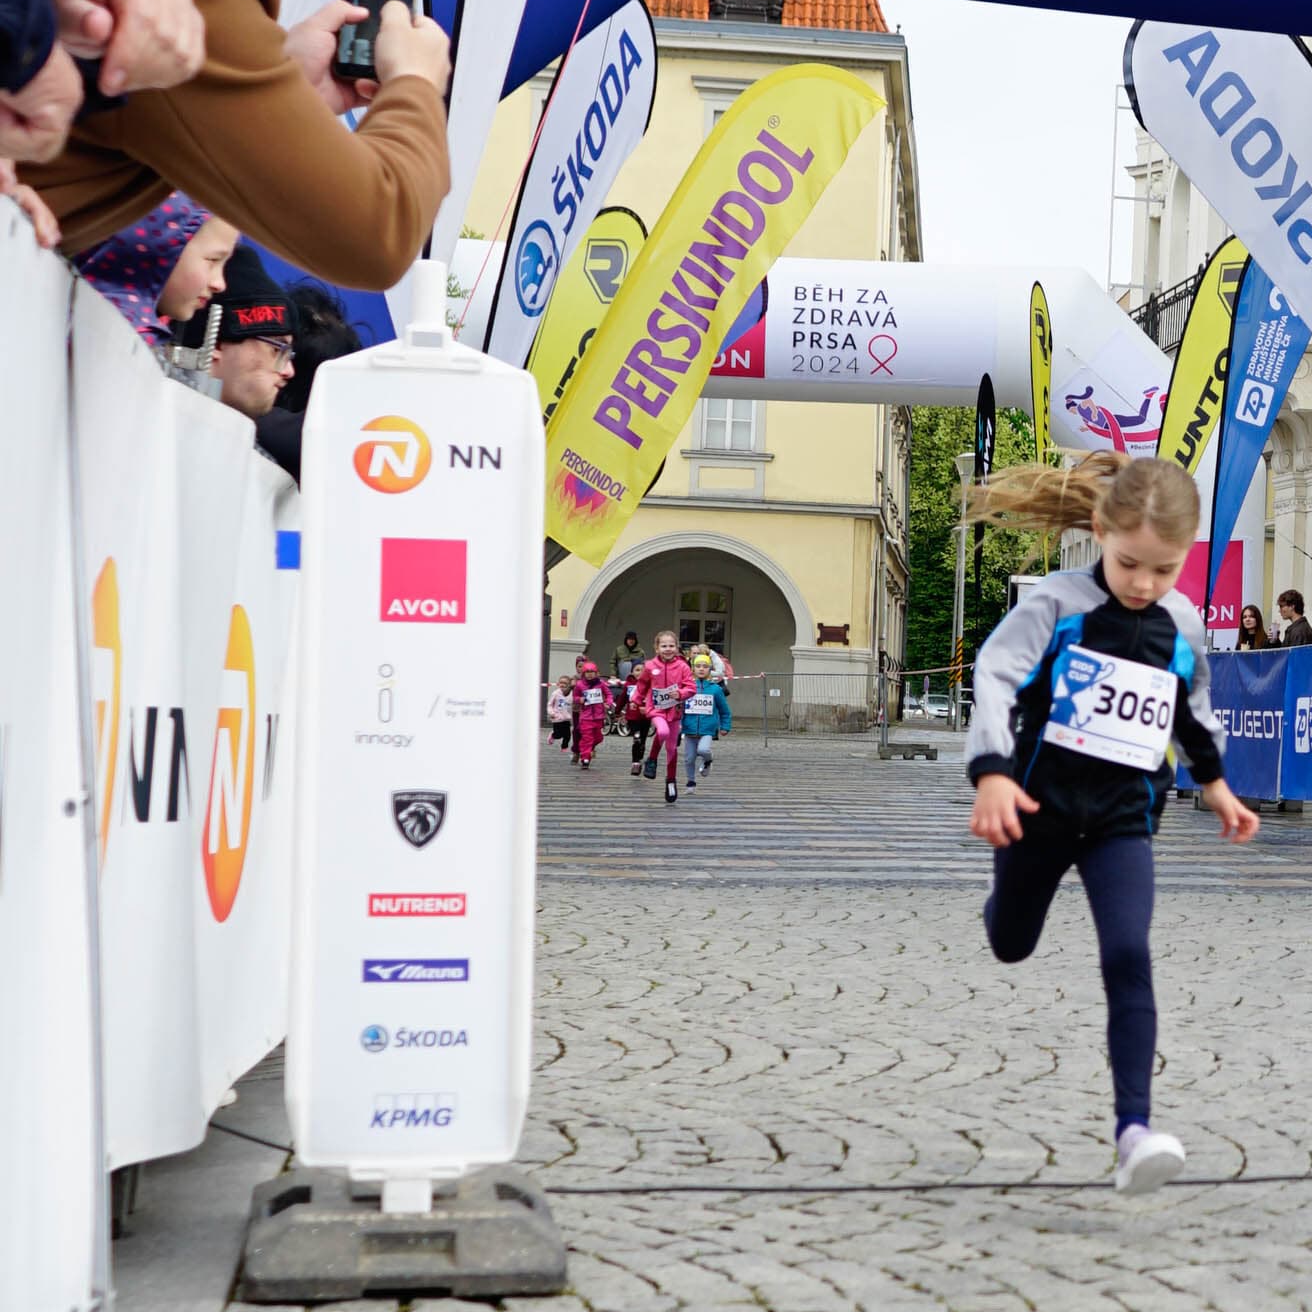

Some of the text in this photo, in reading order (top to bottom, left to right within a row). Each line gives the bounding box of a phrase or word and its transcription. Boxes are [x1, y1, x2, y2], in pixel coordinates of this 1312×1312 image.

[551, 29, 642, 235] ŠKODA
[593, 129, 815, 450] PERSKINDOL
[794, 284, 888, 304] BĚH ZA
[792, 307, 898, 328] ZDRAVÁ
[792, 331, 857, 350] PRSA
[792, 355, 859, 373] 2024
[1271, 350, 1287, 383] VNITRA
[448, 444, 502, 470] NN
[560, 448, 627, 501] PERSKINDOL
[387, 599, 458, 617] AVON
[1093, 684, 1170, 730] 3060
[1214, 709, 1284, 739] PEUGEOT
[354, 731, 415, 748] innogy
[372, 898, 463, 913] NUTREND
[394, 1027, 468, 1048] ŠKODA
[370, 1107, 452, 1128] KPMG
